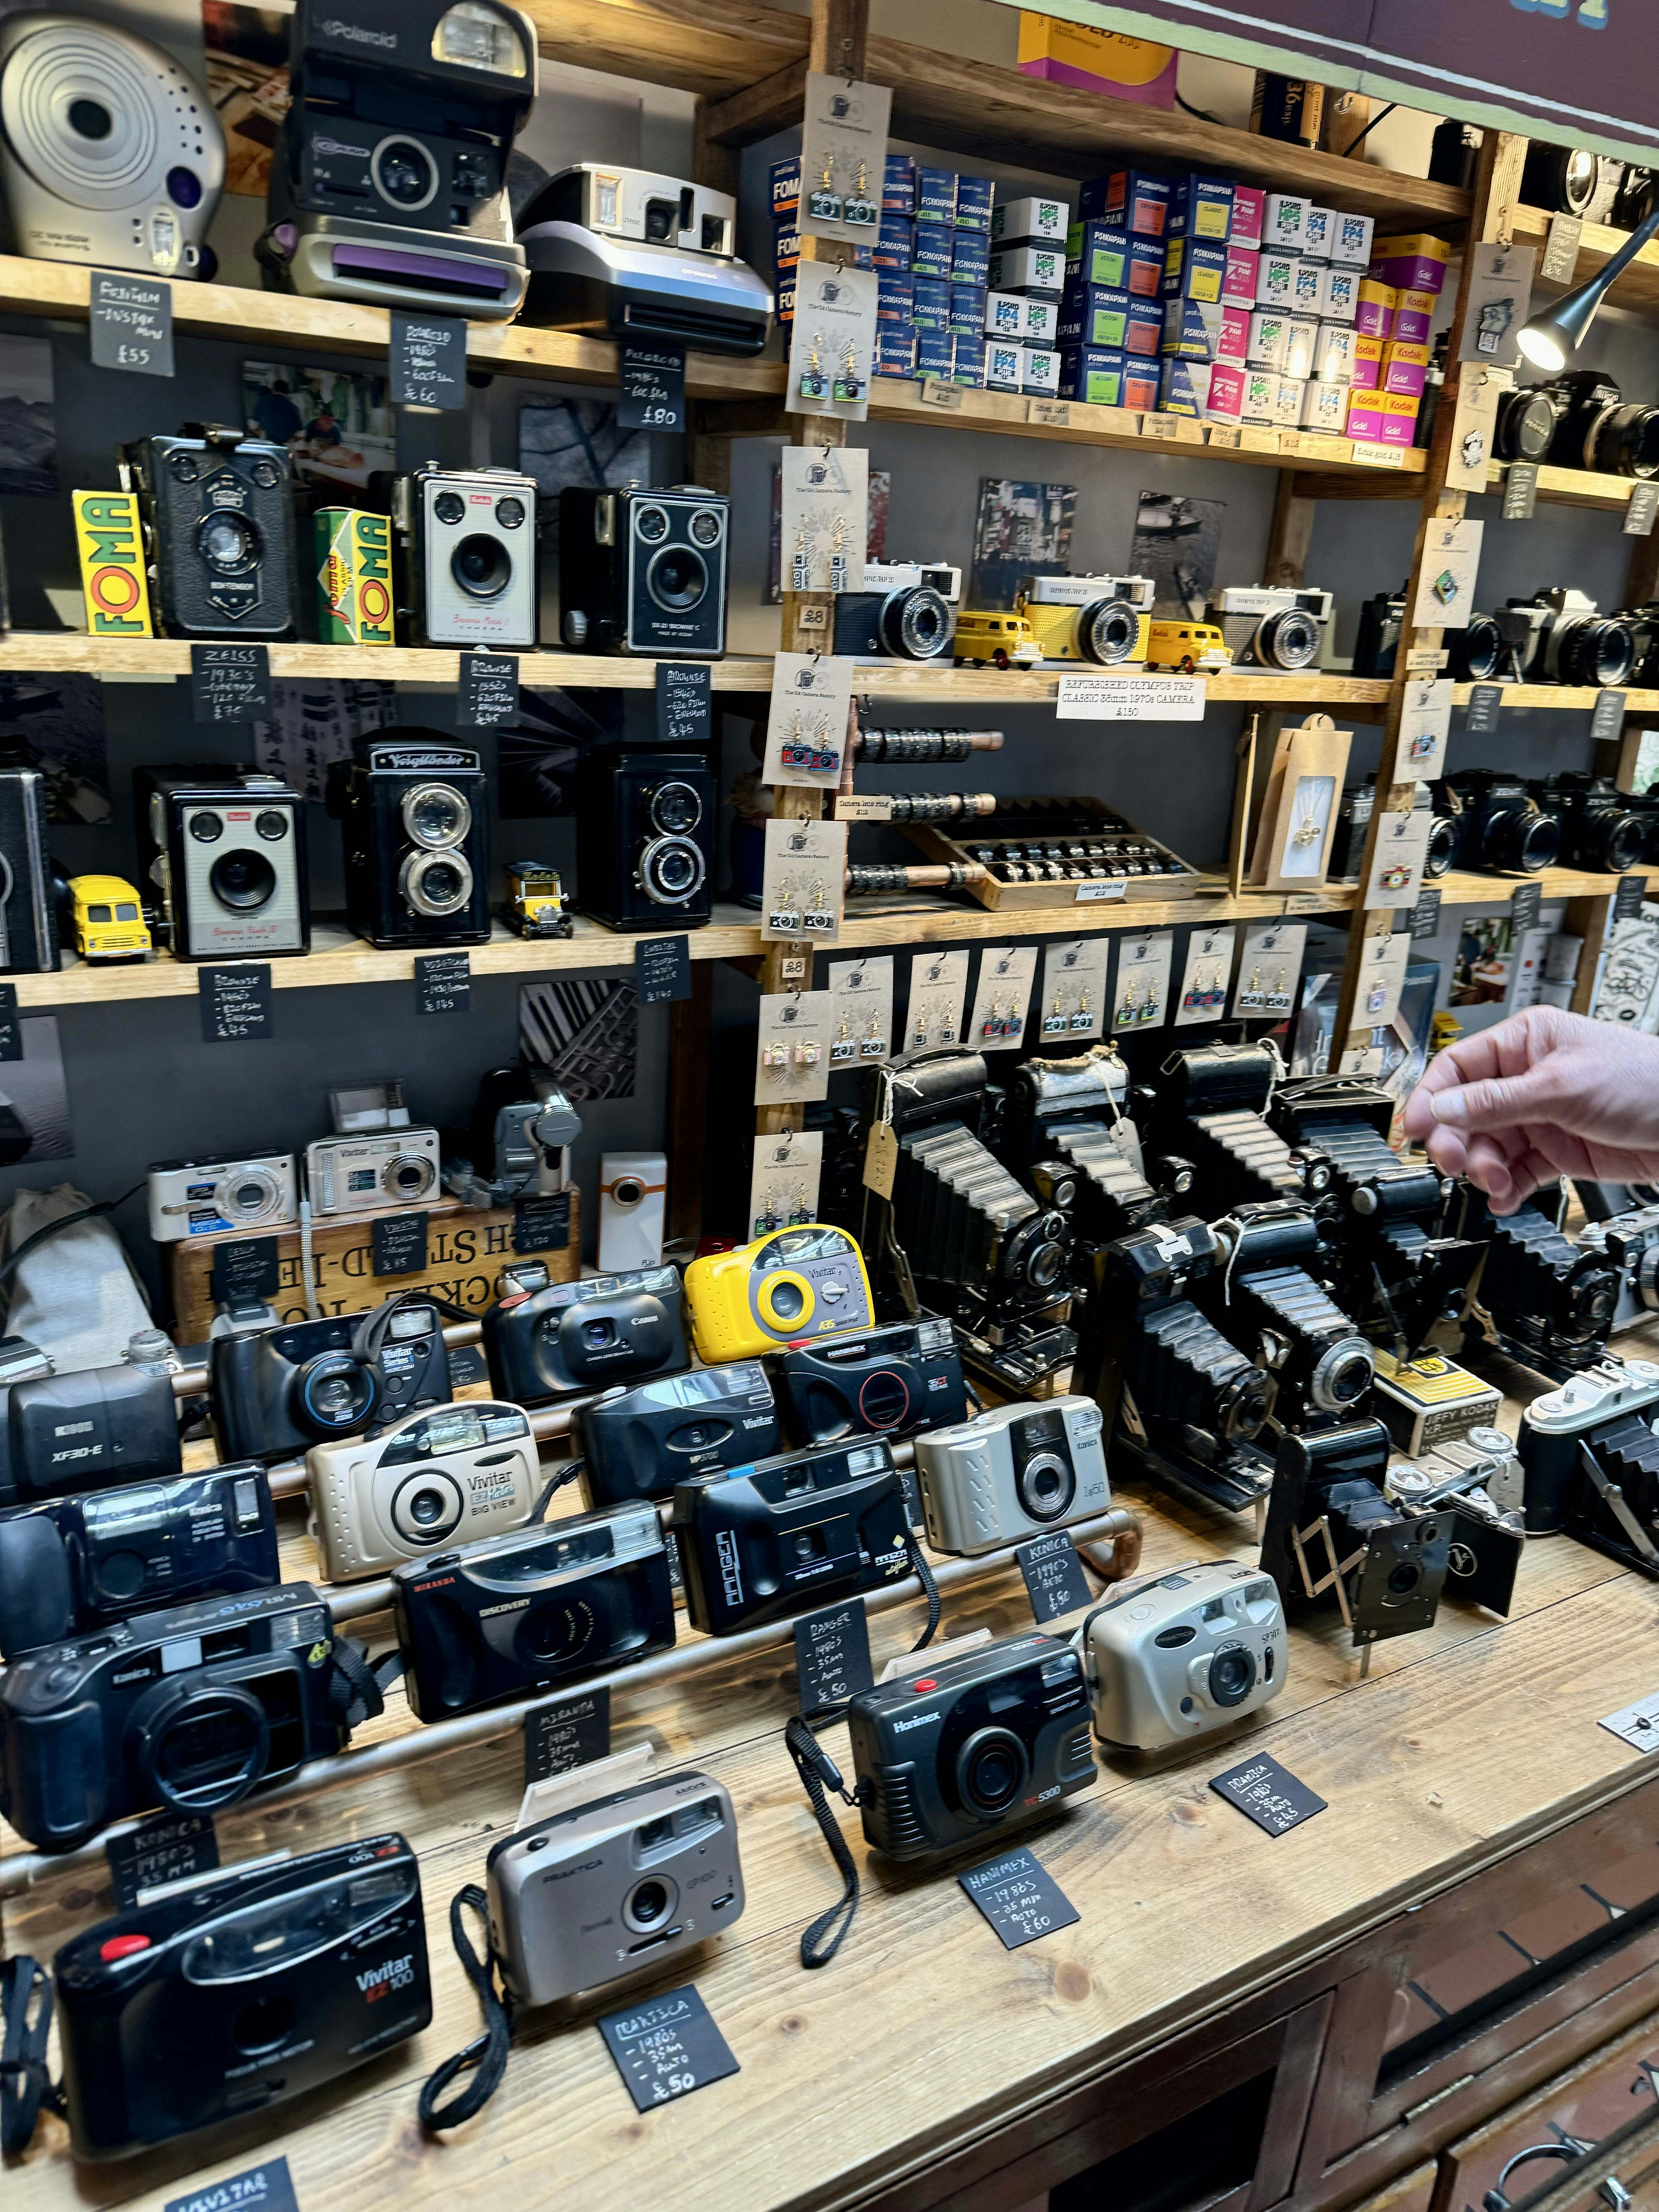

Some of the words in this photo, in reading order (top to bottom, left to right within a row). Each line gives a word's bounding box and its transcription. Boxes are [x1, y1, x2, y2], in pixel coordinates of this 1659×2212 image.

[331, 21, 397, 48] Polaroid
[1240, 206, 1255, 215] PAN
[1278, 208, 1302, 223] HP5
[1307, 218, 1326, 232] FP4
[1094, 231, 1127, 246] FOMAPAN
[1342, 226, 1364, 240] FP4
[917, 251, 952, 263] FOMAPAN
[1193, 248, 1225, 261] FOMAPAN
[954, 259, 989, 271] FOMAPAN
[1237, 267, 1252, 275] PAN
[1267, 268, 1290, 283] HP5
[1418, 270, 1433, 280] Gold
[1296, 276, 1317, 290] FP4
[1331, 283, 1350, 296] FP4
[878, 294, 913, 306] FOMAPAN
[1095, 292, 1128, 304] FOMAPAN
[1407, 295, 1430, 309] Kodak
[914, 304, 950, 316] FOMAPAN
[996, 308, 1018, 321] FP4
[1130, 302, 1163, 316] FOMAPAN
[951, 312, 985, 324] FOMAPAN
[1027, 311, 1047, 322] HP5
[1364, 315, 1379, 326] Gold
[1183, 327, 1218, 340] FOMAPAN
[1228, 327, 1242, 335] PAN
[1259, 326, 1282, 340] HP5
[1400, 323, 1417, 333] Gold
[118, 345, 149, 364] £55
[1087, 354, 1122, 364] FOMAPAN
[1397, 347, 1423, 360] Kodak
[994, 356, 1016, 369] FP4
[1031, 360, 1051, 371] HP5
[1127, 360, 1160, 372] FOMAPAN
[1391, 373, 1409, 384] Gold
[1224, 386, 1238, 394] PAN
[1249, 382, 1270, 396] HP5
[1319, 393, 1339, 406] FP4
[1357, 394, 1381, 406] Kodak
[1390, 400, 1414, 411] Kodak
[641, 405, 677, 425] £80
[1351, 421, 1368, 431] Gold
[1384, 426, 1401, 436] Gold
[82, 497, 145, 633] FOMA
[357, 516, 392, 642] FOMA
[803, 610, 823, 624] £8
[204, 649, 257, 663] ZEISS
[666, 670, 706, 683] BROWNIE
[1065, 680, 1128, 690] REFURBISHED
[1130, 681, 1172, 690] OLYMPUS
[1173, 682, 1195, 691] TRIP
[1062, 694, 1099, 703] CLASSIC
[1100, 694, 1128, 703] 35mm
[1129, 694, 1154, 704] 1970s
[1156, 695, 1195, 704] CAMERA
[1116, 708, 1139, 716] £150
[668, 721, 694, 737] £45
[522, 871, 561, 881] Kodak
[785, 961, 803, 973] £8
[808, 1266, 837, 1278] Vivitar
[630, 1315, 659, 1326] Canon
[818, 1319, 835, 1331] A35
[381, 1347, 414, 1360] Vivitar
[827, 1344, 866, 1358] HANIMEX
[383, 1357, 409, 1368] Series
[1425, 1410, 1457, 1426] JIFFY
[1460, 1401, 1498, 1417] KODAK
[742, 1415, 775, 1429] Vivitar
[1077, 1438, 1098, 1450] Konica
[467, 1470, 513, 1491] Vivitar
[189, 1503, 223, 1517] Konica
[471, 1503, 491, 1516] BIG
[491, 1498, 516, 1512] VIEW
[1029, 1537, 1068, 1562] KONICA
[413, 1576, 455, 1593] MIRANDA
[478, 1597, 532, 1618] DISCOVERY
[1048, 1589, 1071, 1613] £80
[809, 1612, 851, 1637] RANGER
[817, 1681, 848, 1704] £50
[893, 1709, 941, 1734] Hanimex
[1023, 1784, 1061, 1808] TC5300
[1273, 1807, 1299, 1829] £45
[134, 1818, 202, 1851] KONICA
[542, 1858, 604, 1884] PRAKTICA
[968, 1856, 1031, 1889] HANIMEX
[994, 1879, 1037, 1903] 1980's
[1010, 1908, 1038, 1924] AUTO
[1022, 1914, 1051, 1936] £60
[355, 1953, 414, 1992] Vivitar
[388, 1968, 416, 1991] 100
[615, 1999, 690, 2042] PRAKTICA
[639, 2027, 677, 2055] 1980's
[652, 2071, 697, 2101] £50
